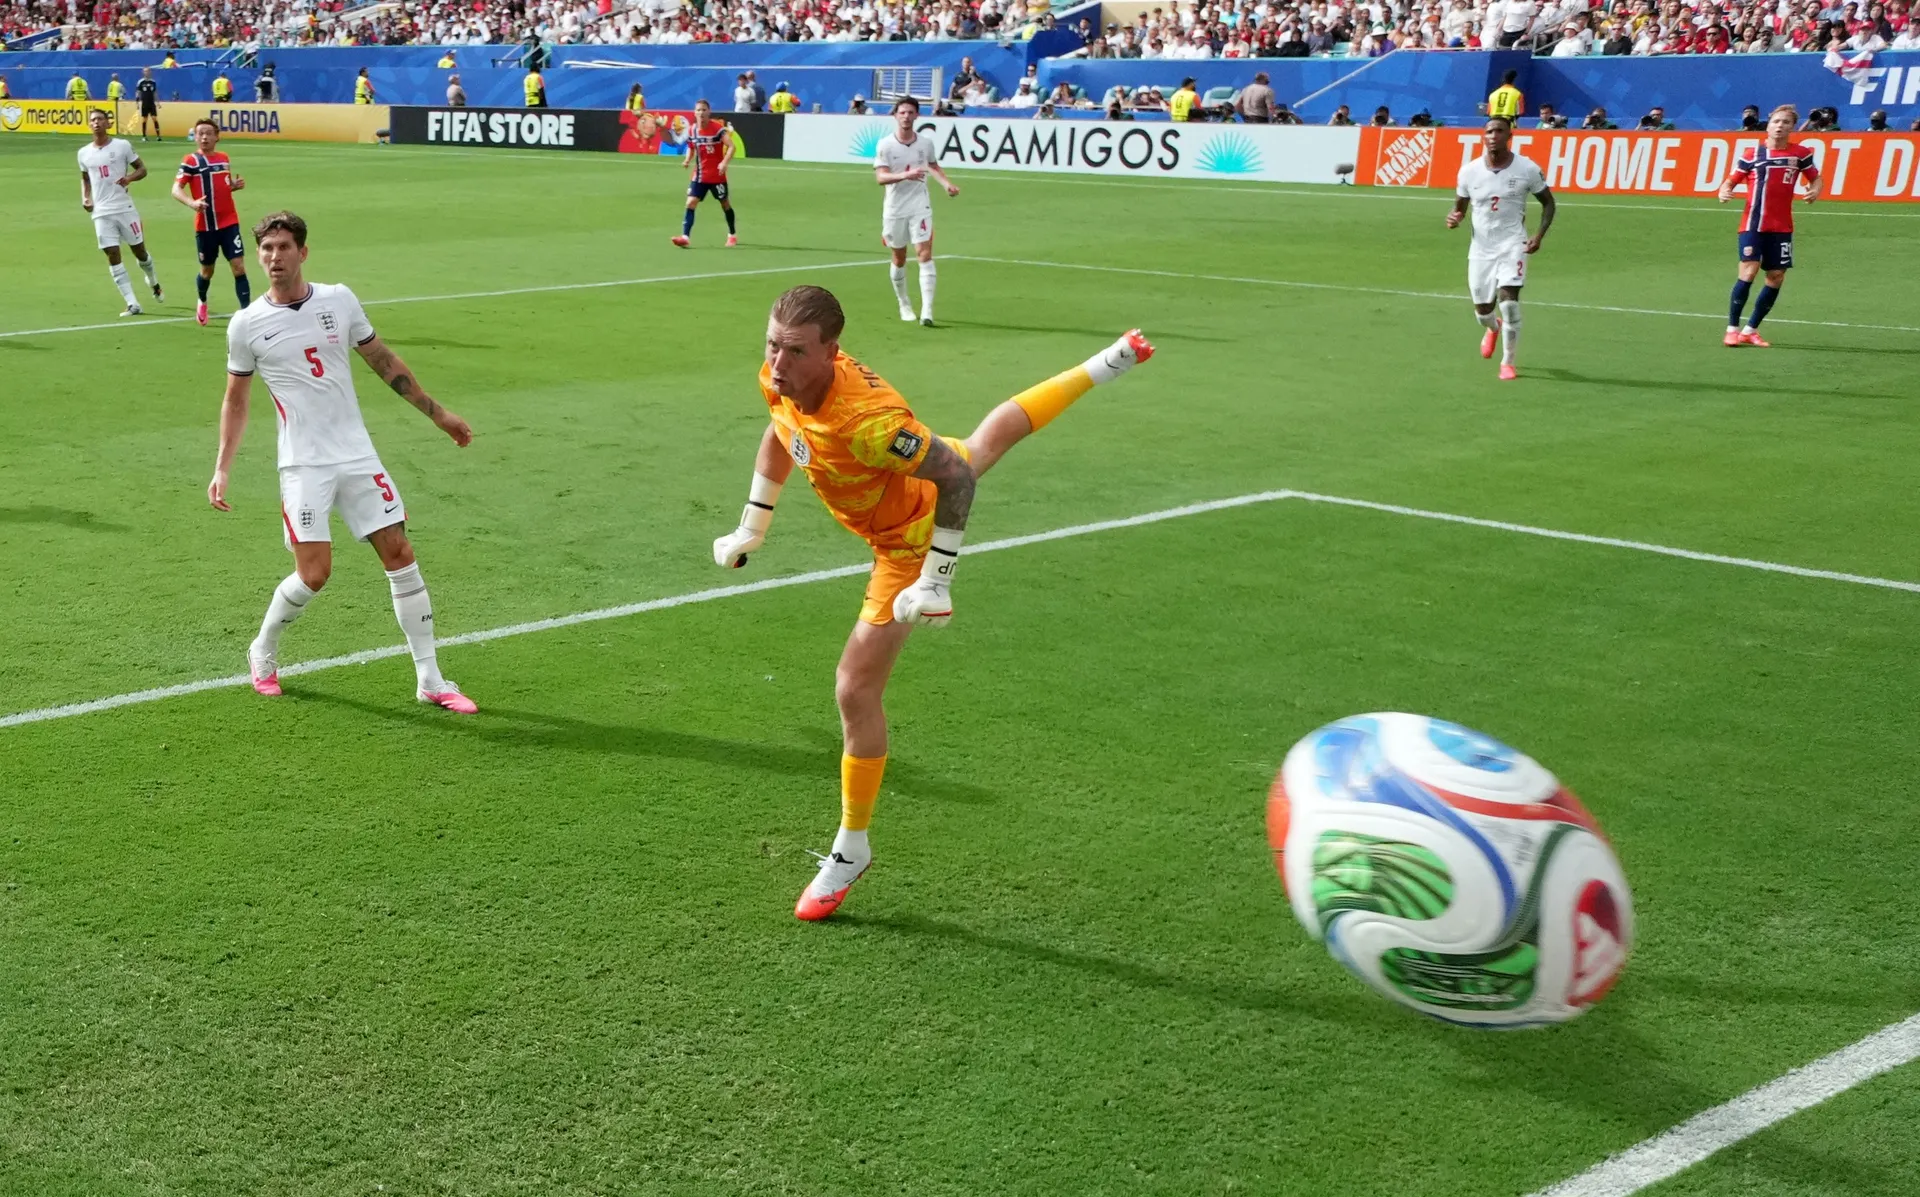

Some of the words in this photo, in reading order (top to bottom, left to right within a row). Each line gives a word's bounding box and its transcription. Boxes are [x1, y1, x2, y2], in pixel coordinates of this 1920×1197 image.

[27, 105, 82, 125] mercado
[210, 110, 280, 132] FLORIDA
[488, 113, 575, 145] STORE
[1384, 134, 1408, 156] THE
[1376, 129, 1434, 185] HOME
[1396, 150, 1431, 185] DEPOT
[1458, 134, 1534, 170] TE
[1546, 136, 1681, 191] HOME
[1694, 138, 1862, 196] DEOT
[1874, 140, 1920, 197] D
[98, 165, 110, 178] 10
[1491, 196, 1499, 211] 2
[920, 219, 927, 231] 4
[234, 235, 242, 248] 6
[1516, 260, 1523, 276] 2
[304, 347, 324, 378] 5
[373, 473, 394, 502] 5
